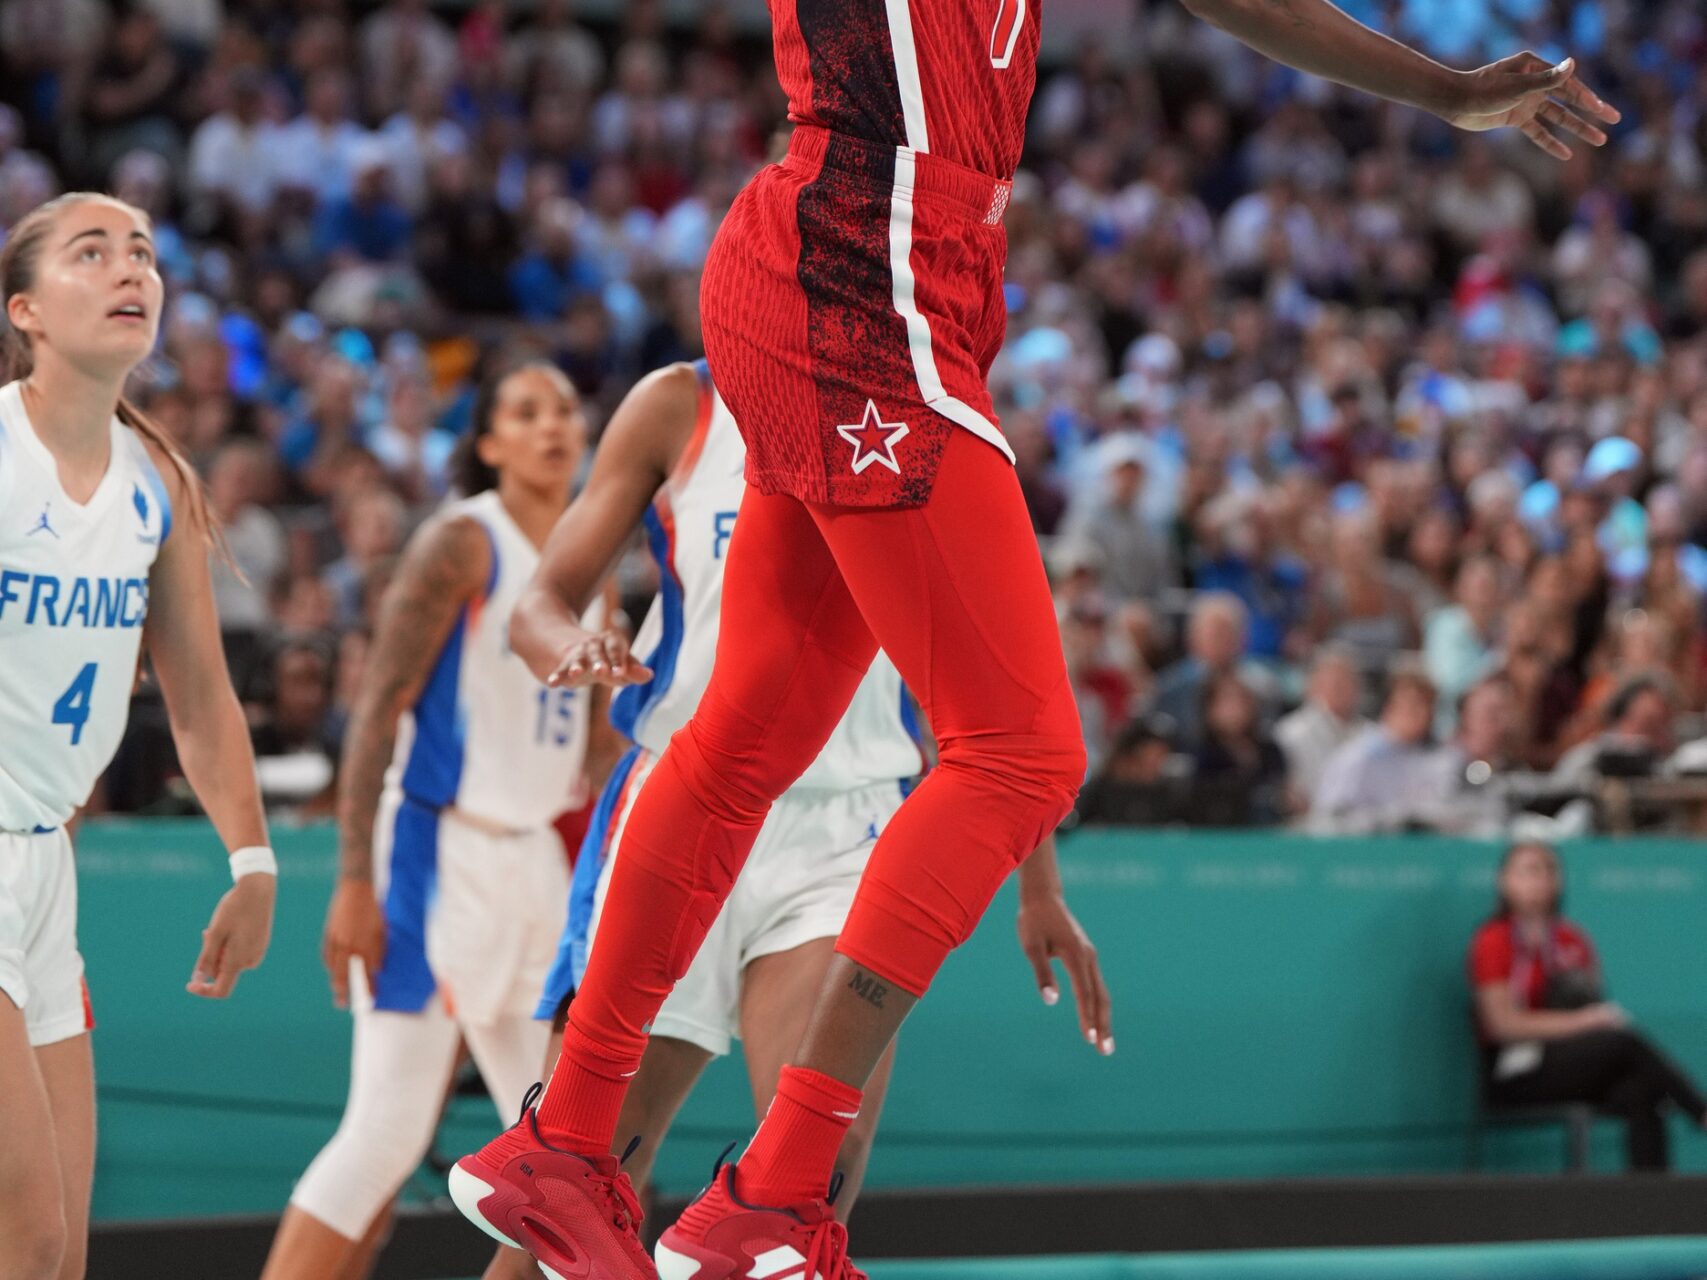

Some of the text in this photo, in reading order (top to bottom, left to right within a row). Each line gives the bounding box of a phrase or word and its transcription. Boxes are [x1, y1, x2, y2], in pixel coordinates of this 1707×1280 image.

[0, 569, 149, 629] FRANC
[51, 662, 98, 746] 4
[535, 687, 577, 746] 15
